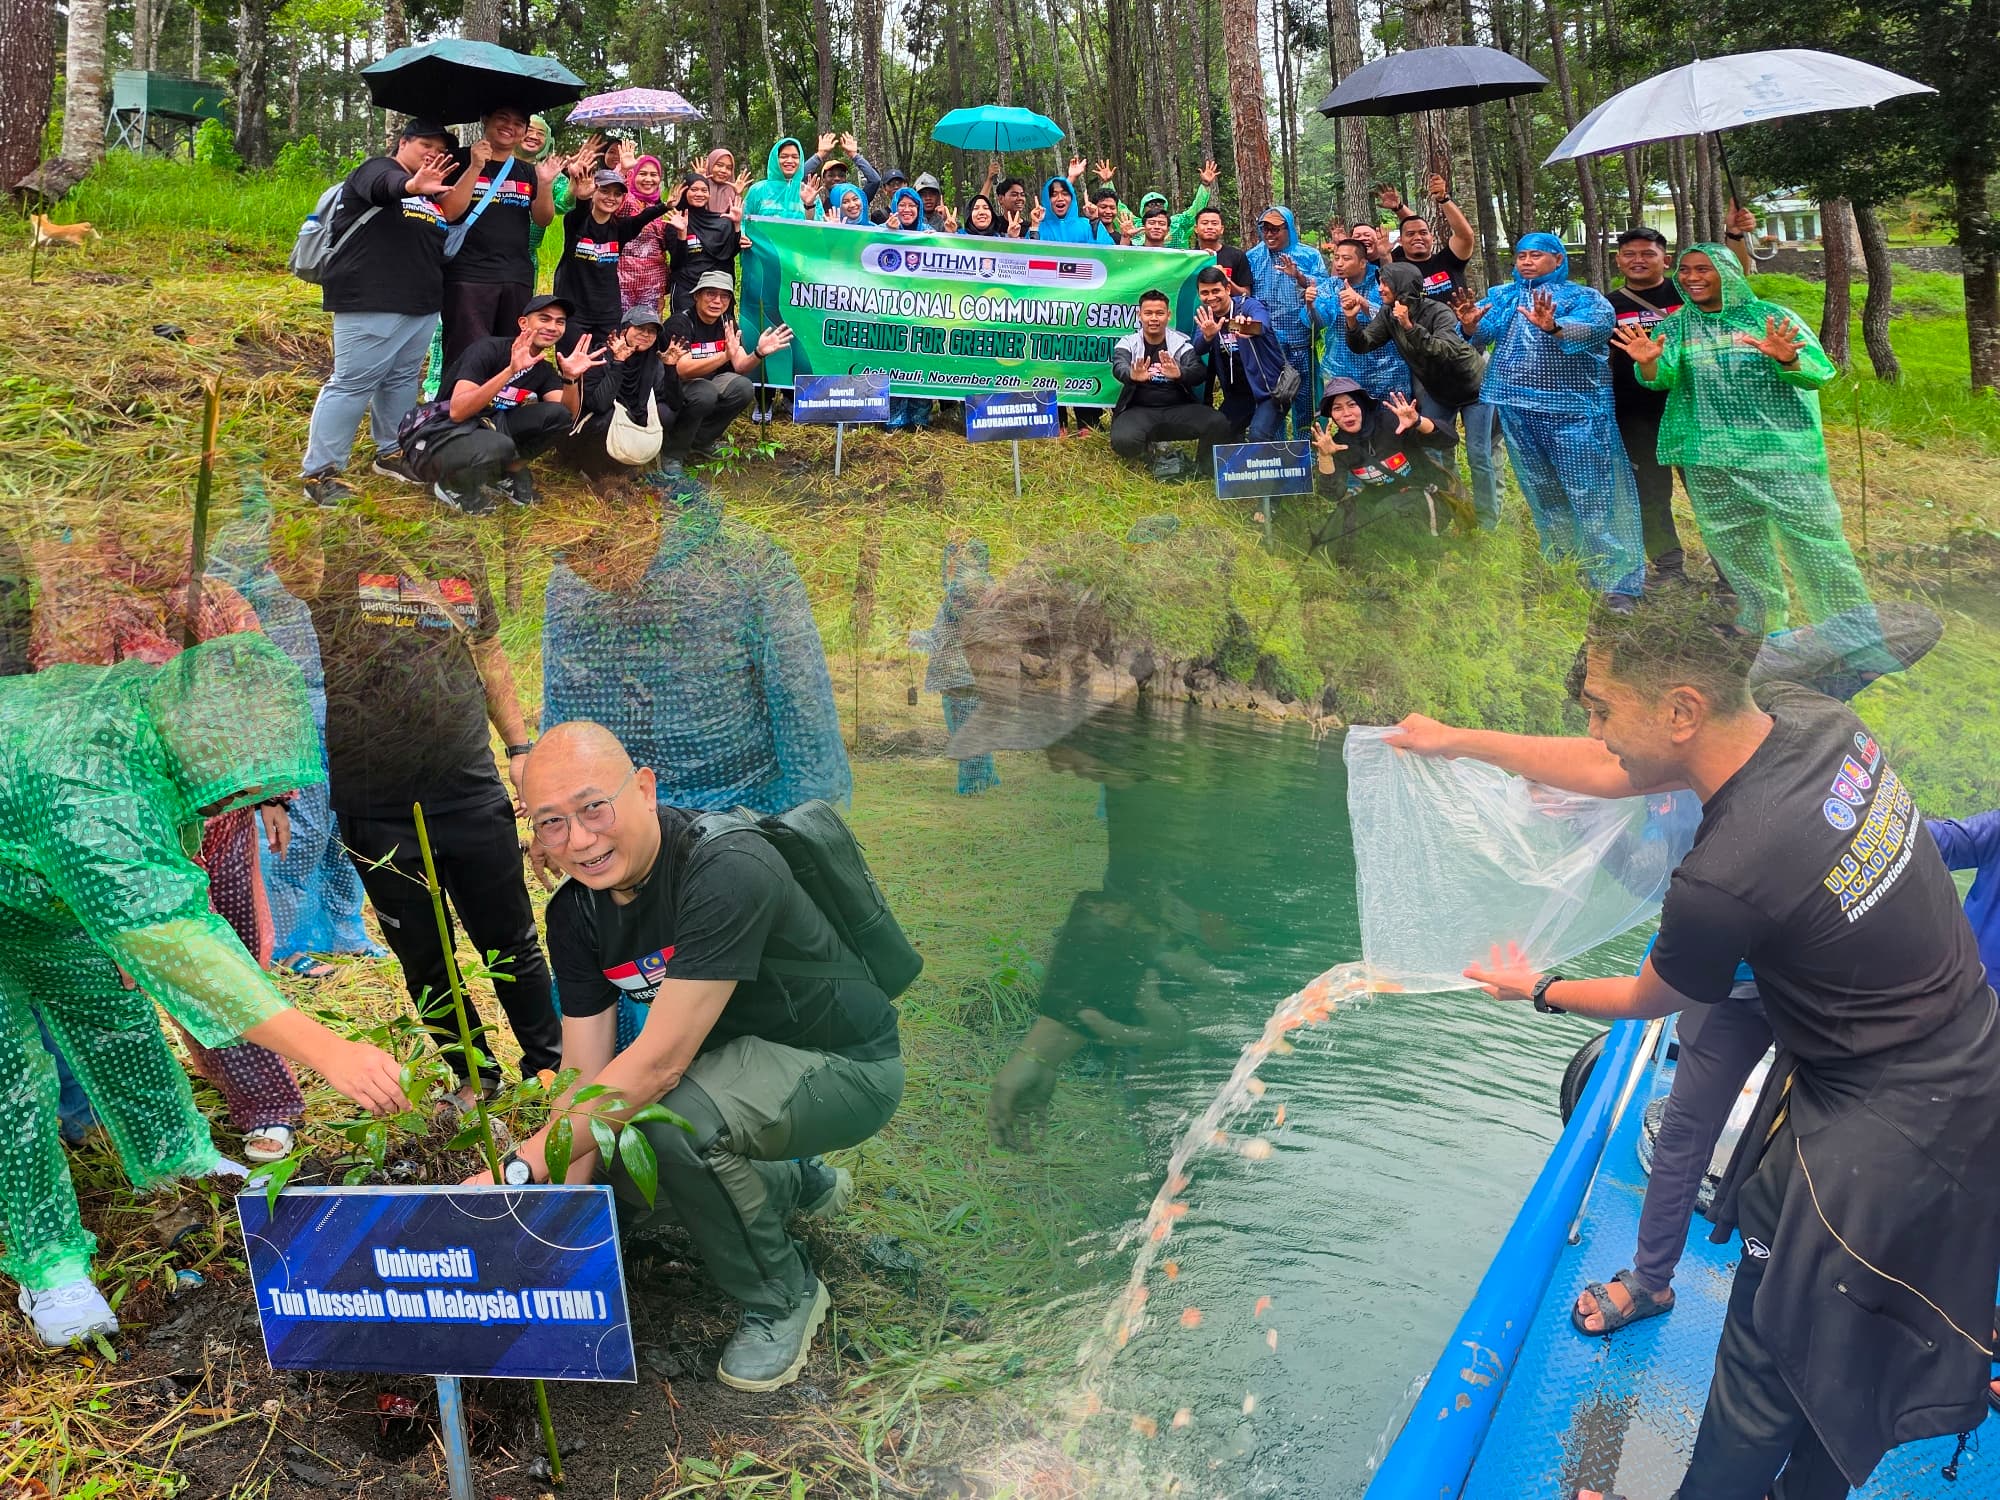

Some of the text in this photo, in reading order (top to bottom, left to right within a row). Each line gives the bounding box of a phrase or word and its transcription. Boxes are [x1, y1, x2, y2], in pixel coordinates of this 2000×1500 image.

[923, 252, 976, 270] UTHM
[790, 281, 1142, 329] INTERNATIONAL COMMUNITY SERVI
[824, 319, 908, 352] GREENING
[910, 325, 946, 355] FOR
[950, 329, 1026, 359] GREENER
[889, 370, 924, 383] Nauli,
[928, 371, 992, 385] November
[995, 375, 1021, 387] 26th
[1032, 377, 1060, 390] 28th,
[986, 403, 1037, 415] UNIVERSITAS
[972, 416, 1028, 429] LABUHANBATU
[1223, 470, 1259, 481] Teknologi
[1246, 457, 1281, 468] Universiti
[360, 601, 419, 614] UNIVERSITAS
[1824, 853, 1860, 894] ULB
[1839, 814, 1906, 911] ACADEMIC
[1847, 846, 1912, 923] International
[373, 1247, 473, 1279] Universiti
[269, 1288, 304, 1316] Tun
[309, 1288, 384, 1318] Hussein
[386, 1289, 427, 1319] Onn
[430, 1290, 520, 1323] Malaysia
[534, 1290, 594, 1320] UTHM
